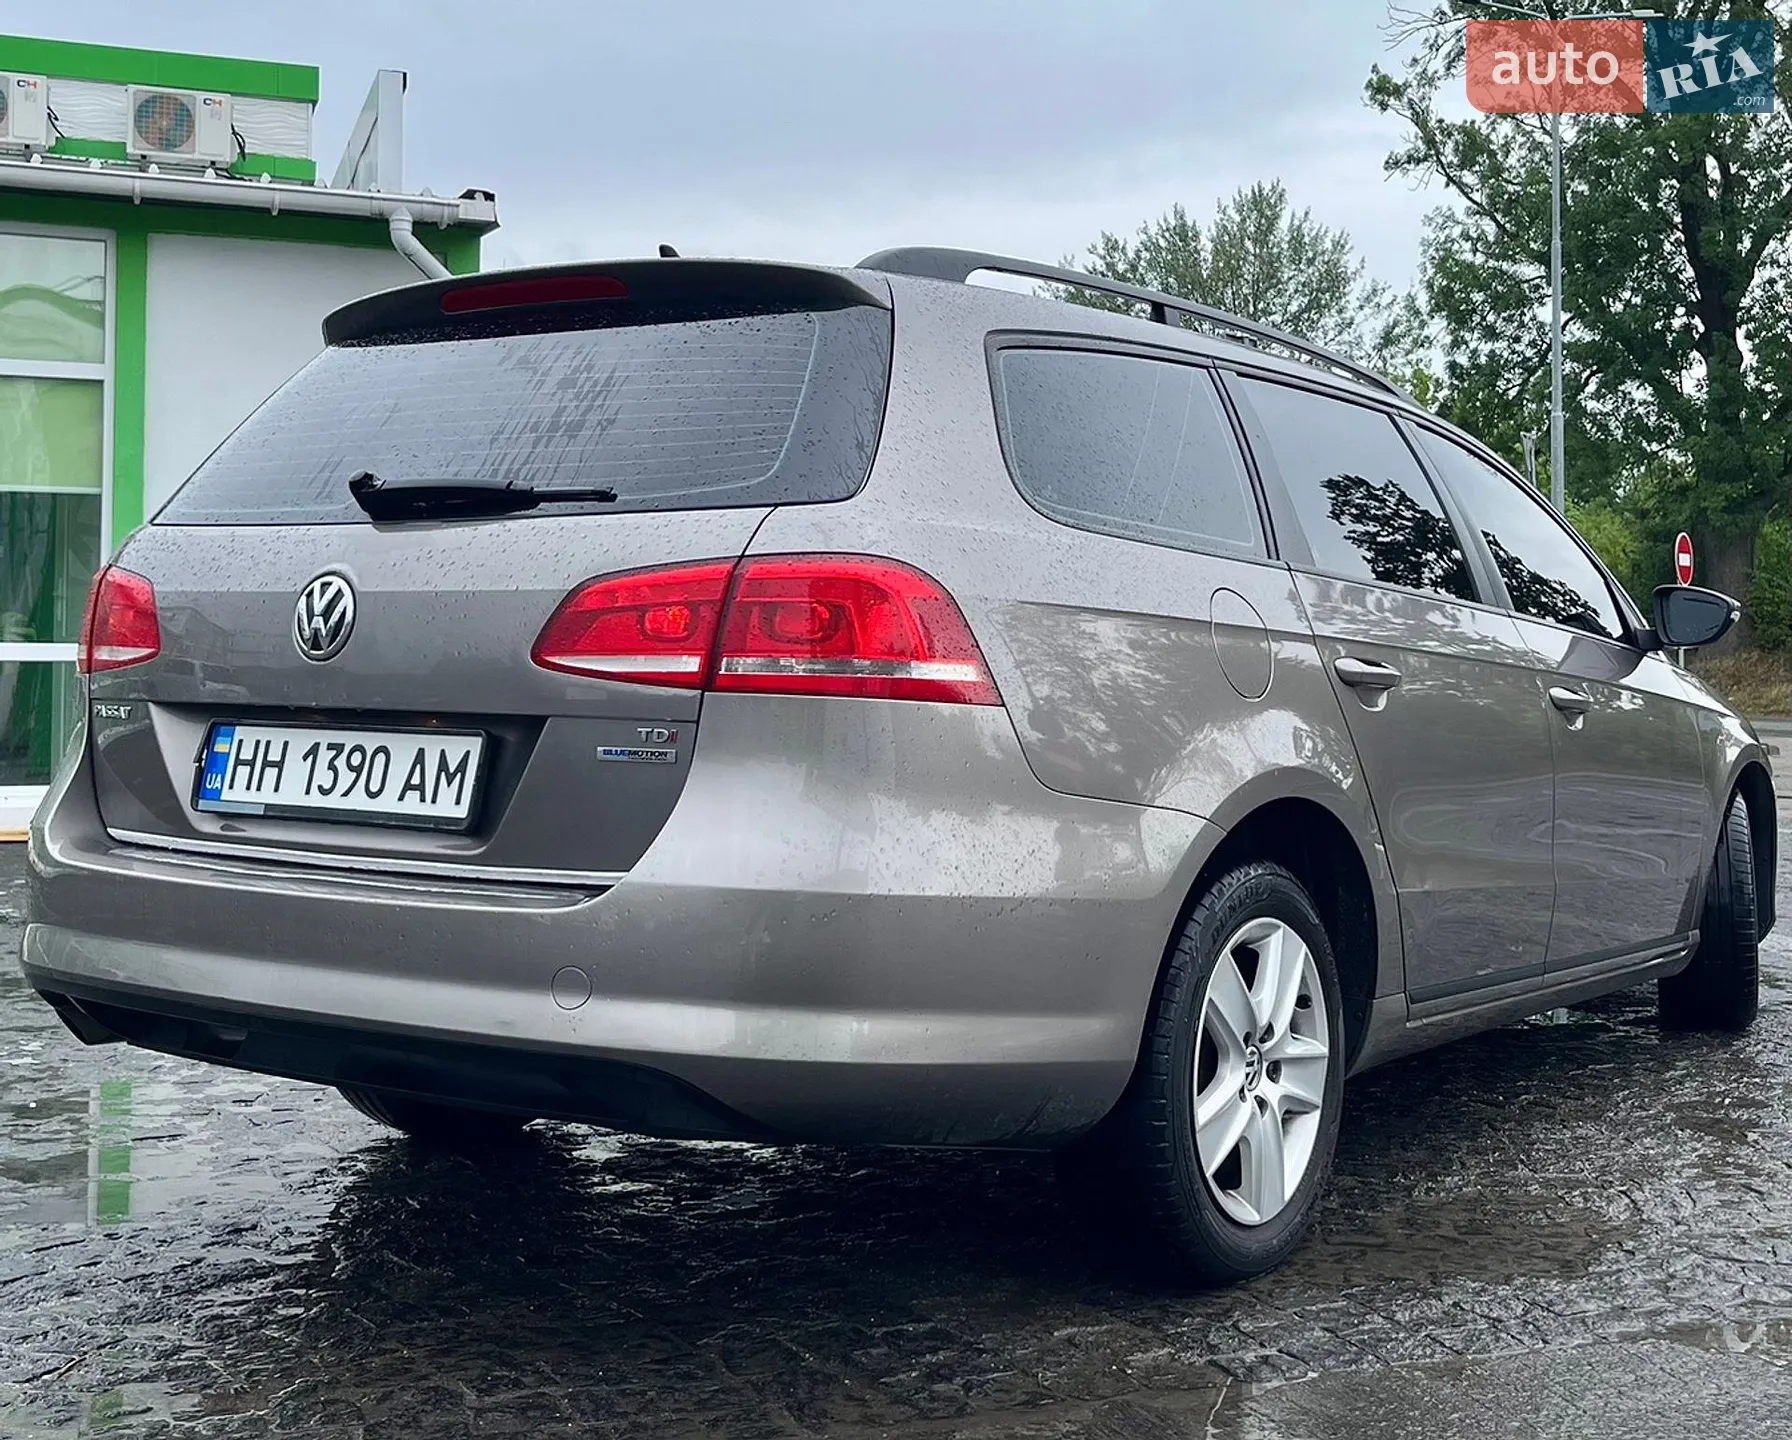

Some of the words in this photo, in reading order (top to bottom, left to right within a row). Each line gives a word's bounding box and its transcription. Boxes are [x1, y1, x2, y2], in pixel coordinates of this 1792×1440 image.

[16, 79, 38, 89] CH
[228, 738, 289, 793] HH
[302, 742, 391, 799] 1390
[397, 746, 471, 806] AM
[205, 773, 221, 790] UA
